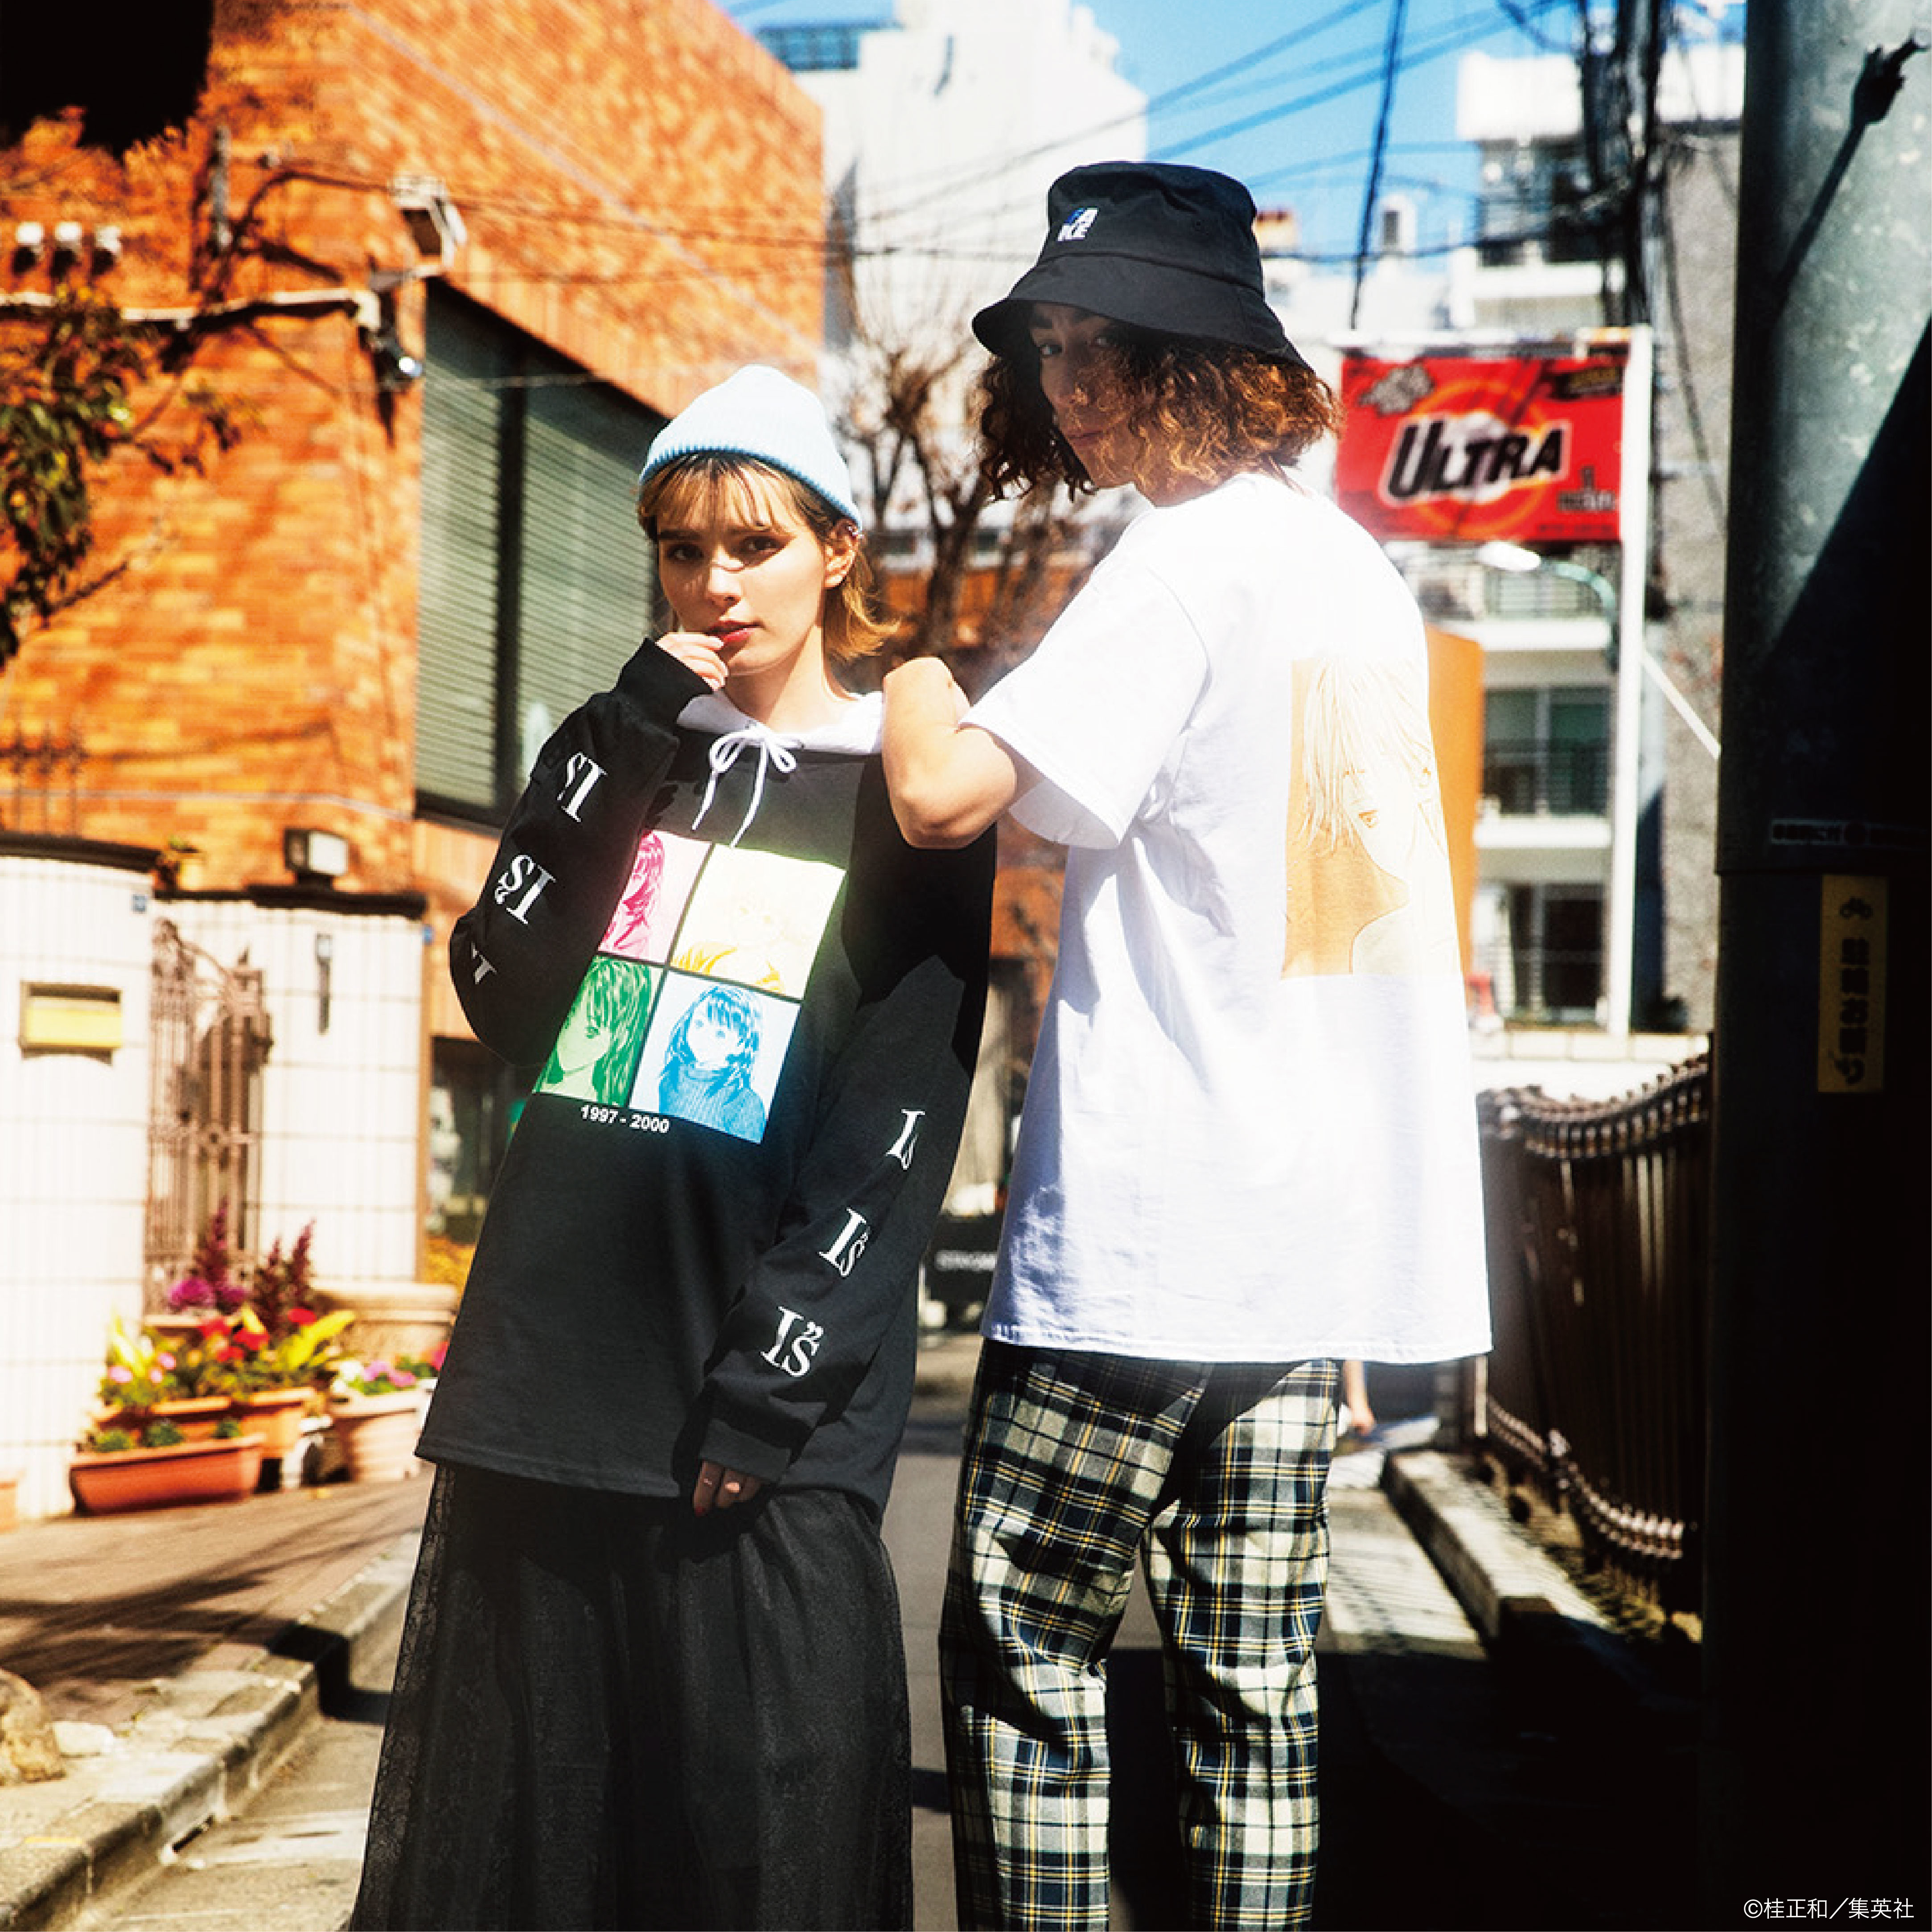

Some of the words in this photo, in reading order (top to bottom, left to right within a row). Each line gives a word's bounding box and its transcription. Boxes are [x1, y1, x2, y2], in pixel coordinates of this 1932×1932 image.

[1385, 417, 1564, 499] ULTRA
[580, 1105, 618, 1123] 1997
[629, 1114, 669, 1133] 2000
